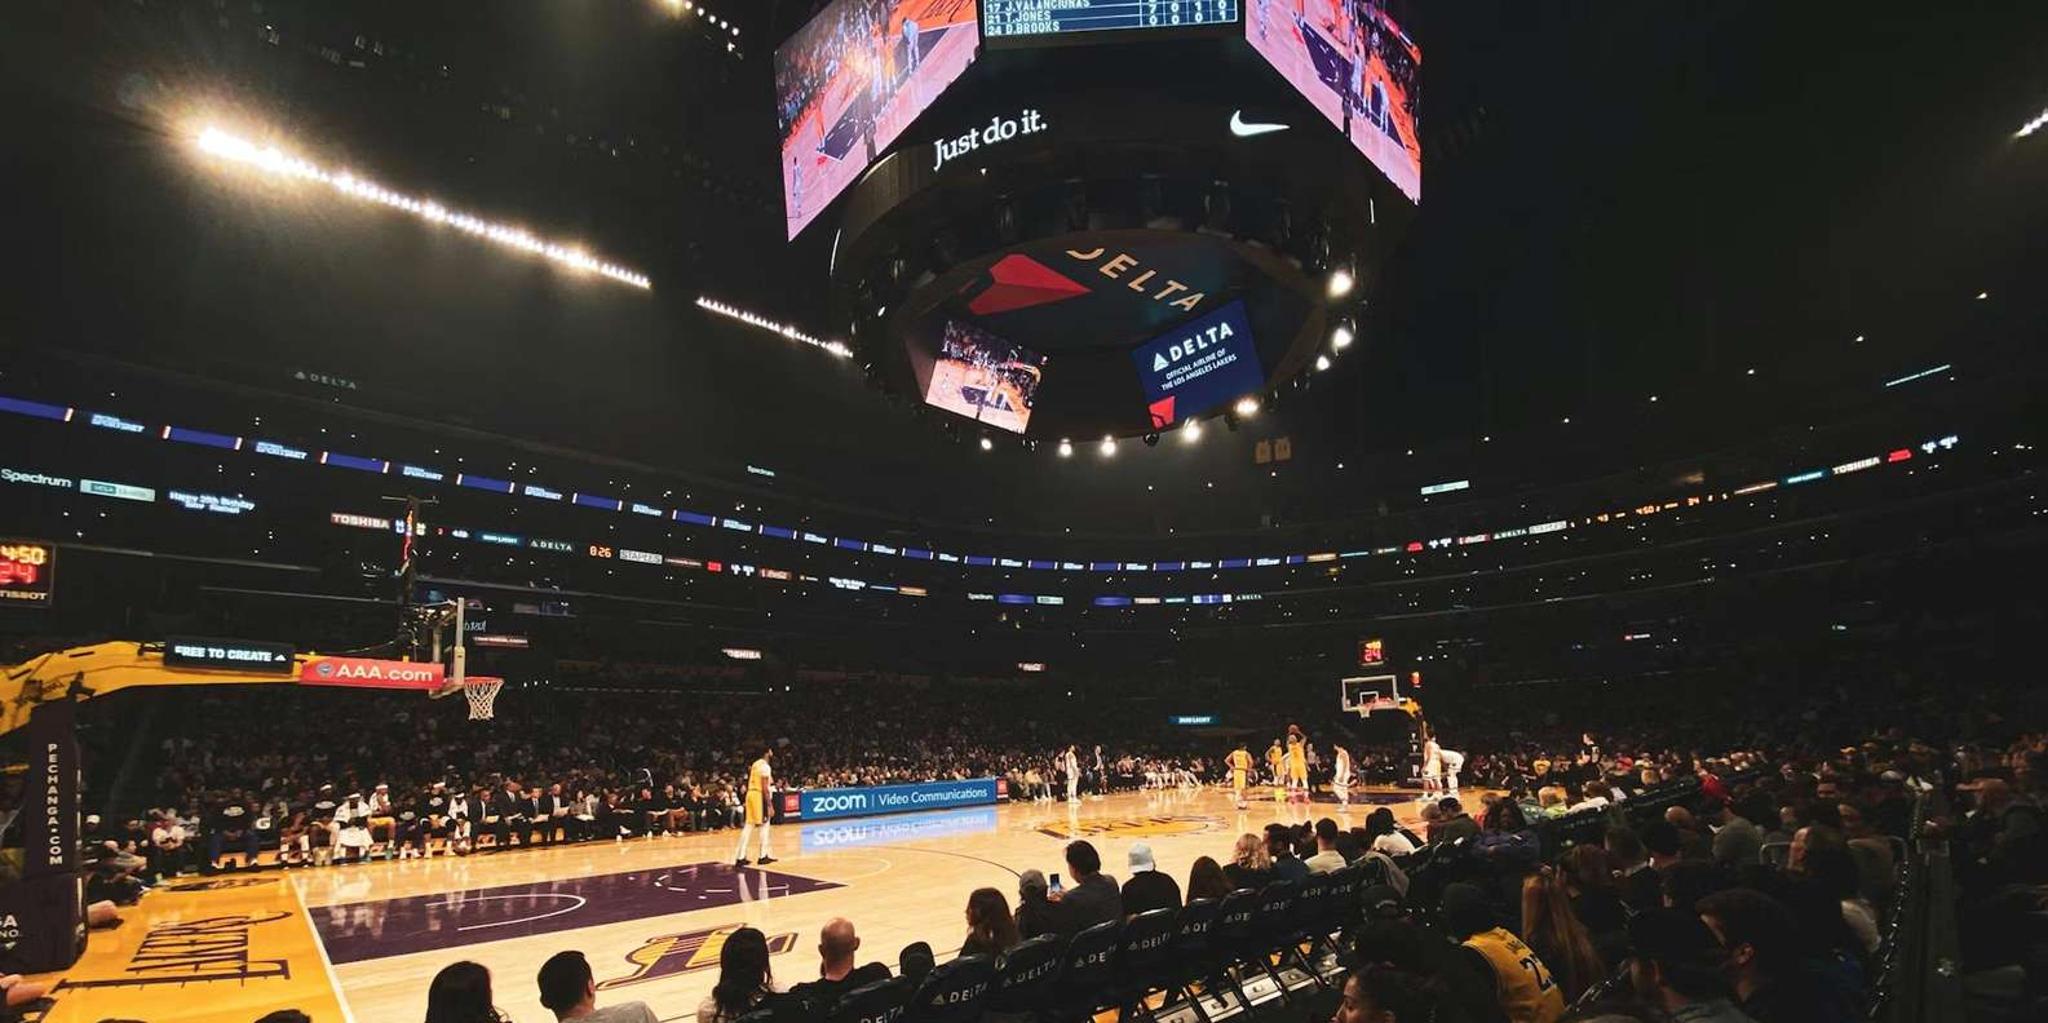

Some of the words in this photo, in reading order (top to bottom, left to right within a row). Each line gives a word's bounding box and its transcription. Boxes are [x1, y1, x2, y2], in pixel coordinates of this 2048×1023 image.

[988, 3, 1000, 13] 17
[988, 13, 1001, 24] 21
[1006, 10, 1051, 23] T.JONES
[1149, 4, 1157, 14] 7
[1171, 2, 1179, 12] 0
[1195, 1, 1202, 11] 1
[1218, 0, 1226, 10] 0
[988, 25, 1002, 36] 24
[1006, 21, 1060, 35] D.BROOKS
[1149, 15, 1158, 26] 0
[1171, 14, 1180, 24] 0
[1195, 12, 1203, 23] 0
[1219, 10, 1226, 20] 1
[933, 139, 980, 172] Just
[982, 116, 1018, 144] do
[1021, 109, 1048, 134] it.
[1169, 321, 1234, 362] DELTA
[1161, 380, 1174, 391] THE
[1173, 375, 1186, 386] LOS
[1186, 363, 1213, 381] ANGELES
[1212, 353, 1238, 369] LAKERS
[1166, 364, 1192, 380] OFFICIAL
[1193, 352, 1216, 368] AIRLINE
[1216, 347, 1226, 358] OF
[1832, 456, 1880, 474] TOSHIBA
[0, 468, 73, 488] Spectrum
[331, 513, 391, 530] TOSHIBA
[540, 541, 573, 552] DELTA
[622, 550, 662, 564] STAPLES
[0, 562, 36, 584] 24
[175, 645, 206, 658] FREE
[208, 648, 225, 659] TO
[227, 649, 272, 662] CREATE
[336, 663, 433, 682] AAA.com
[812, 794, 867, 813] zoom
[878, 793, 909, 807] Video
[911, 787, 988, 804] Communications
